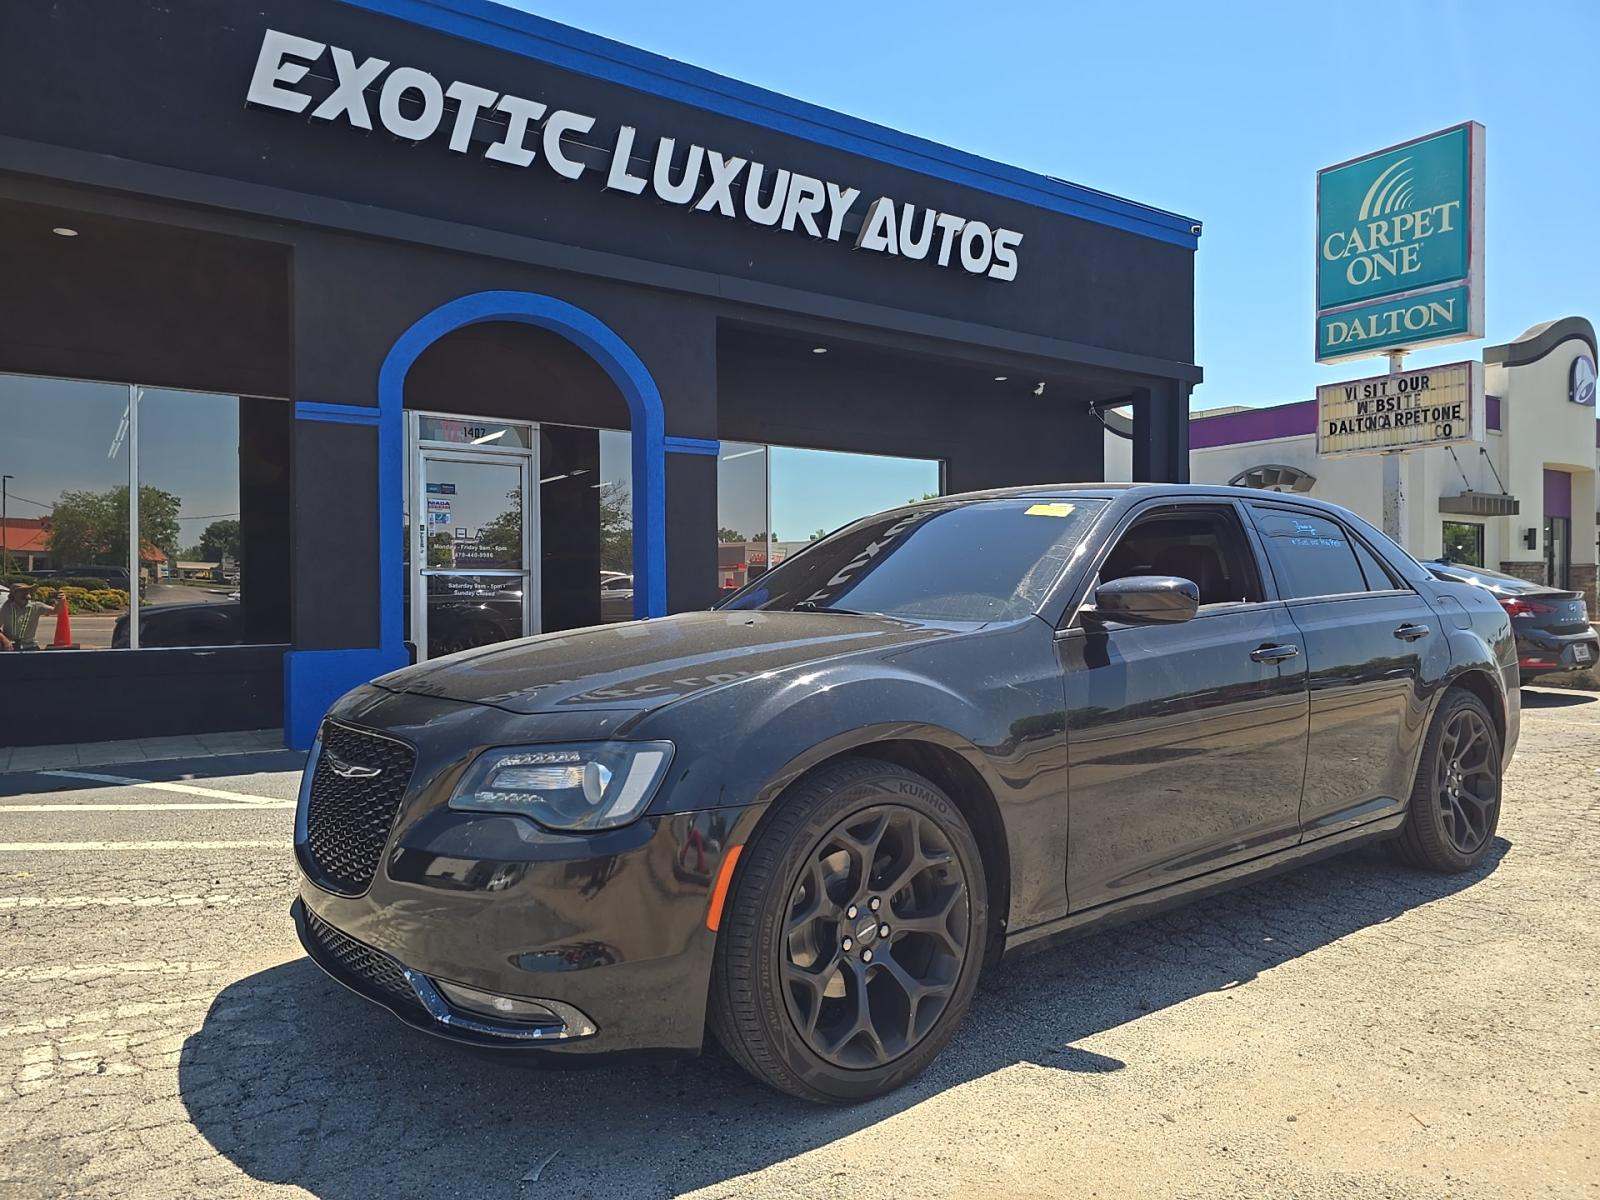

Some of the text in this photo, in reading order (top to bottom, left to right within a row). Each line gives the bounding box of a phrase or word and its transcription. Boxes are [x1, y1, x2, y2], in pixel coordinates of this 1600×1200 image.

[246, 28, 1025, 283] EXOTIC LUXURY AUTOS
[1323, 200, 1460, 261] CARPET
[1346, 243, 1422, 286] ONE
[1326, 298, 1456, 346] DALTON
[1398, 375, 1430, 393] OUR
[448, 582, 473, 590] Saturday
[453, 589, 475, 597] Sunday
[899, 782, 948, 814] KUMHO
